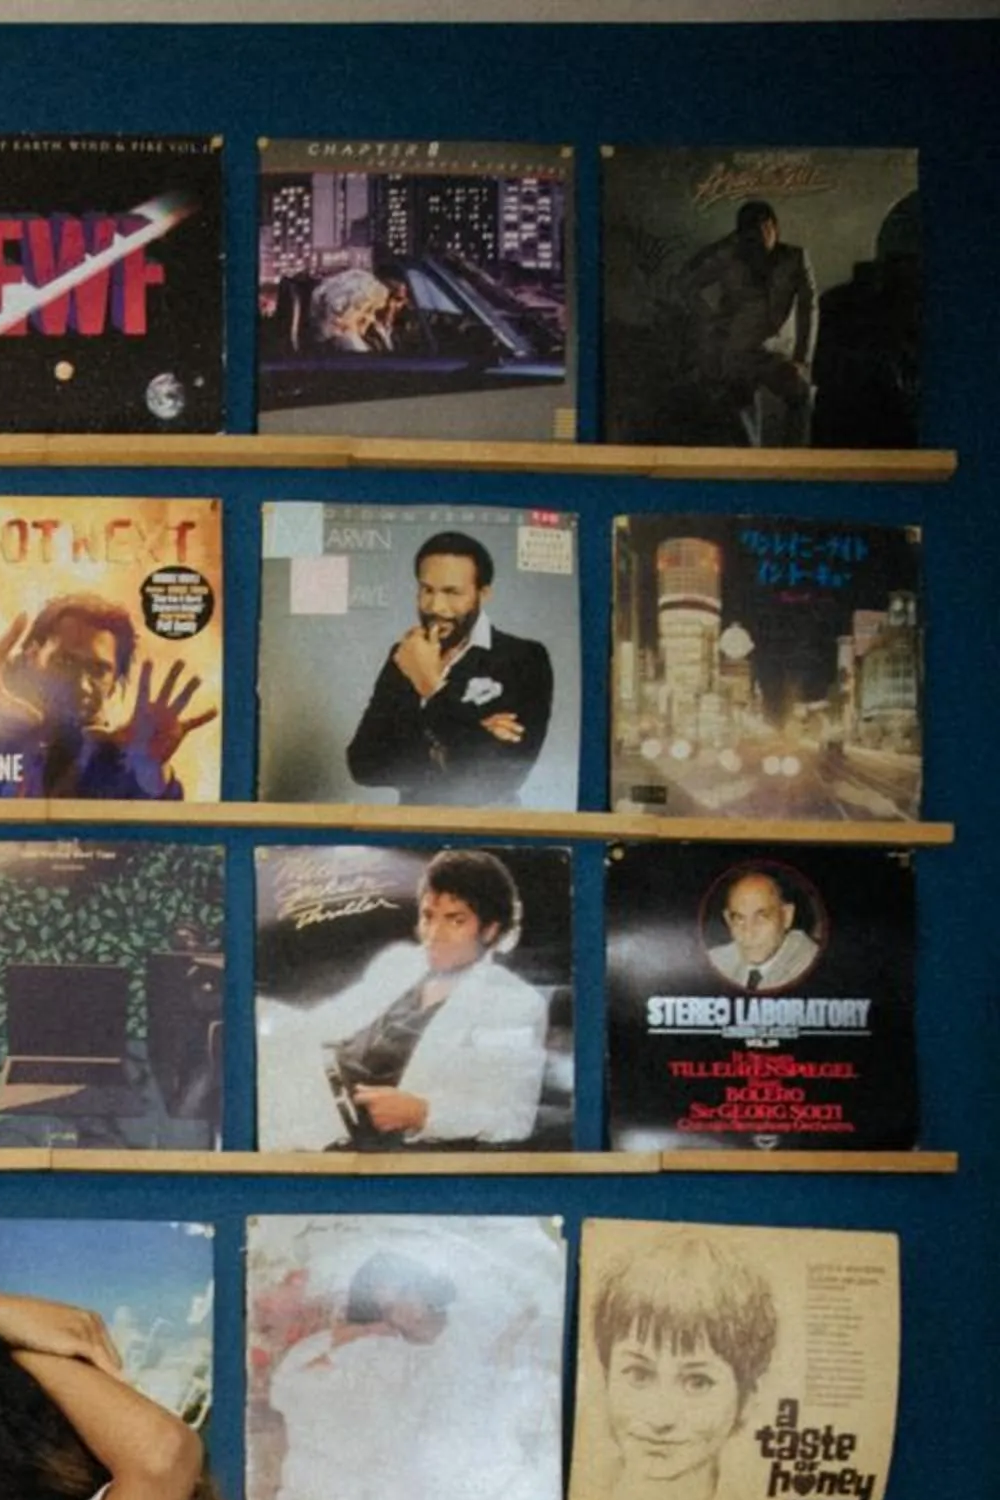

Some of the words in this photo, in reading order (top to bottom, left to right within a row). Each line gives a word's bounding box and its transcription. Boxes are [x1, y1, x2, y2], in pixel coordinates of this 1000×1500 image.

[308, 142, 420, 157] CHAPTER
[71, 519, 197, 564] NEXT
[647, 996, 730, 1027] STEREO
[735, 997, 872, 1029] LABORATORY
[776, 1398, 799, 1429] a
[755, 1424, 857, 1461] taste
